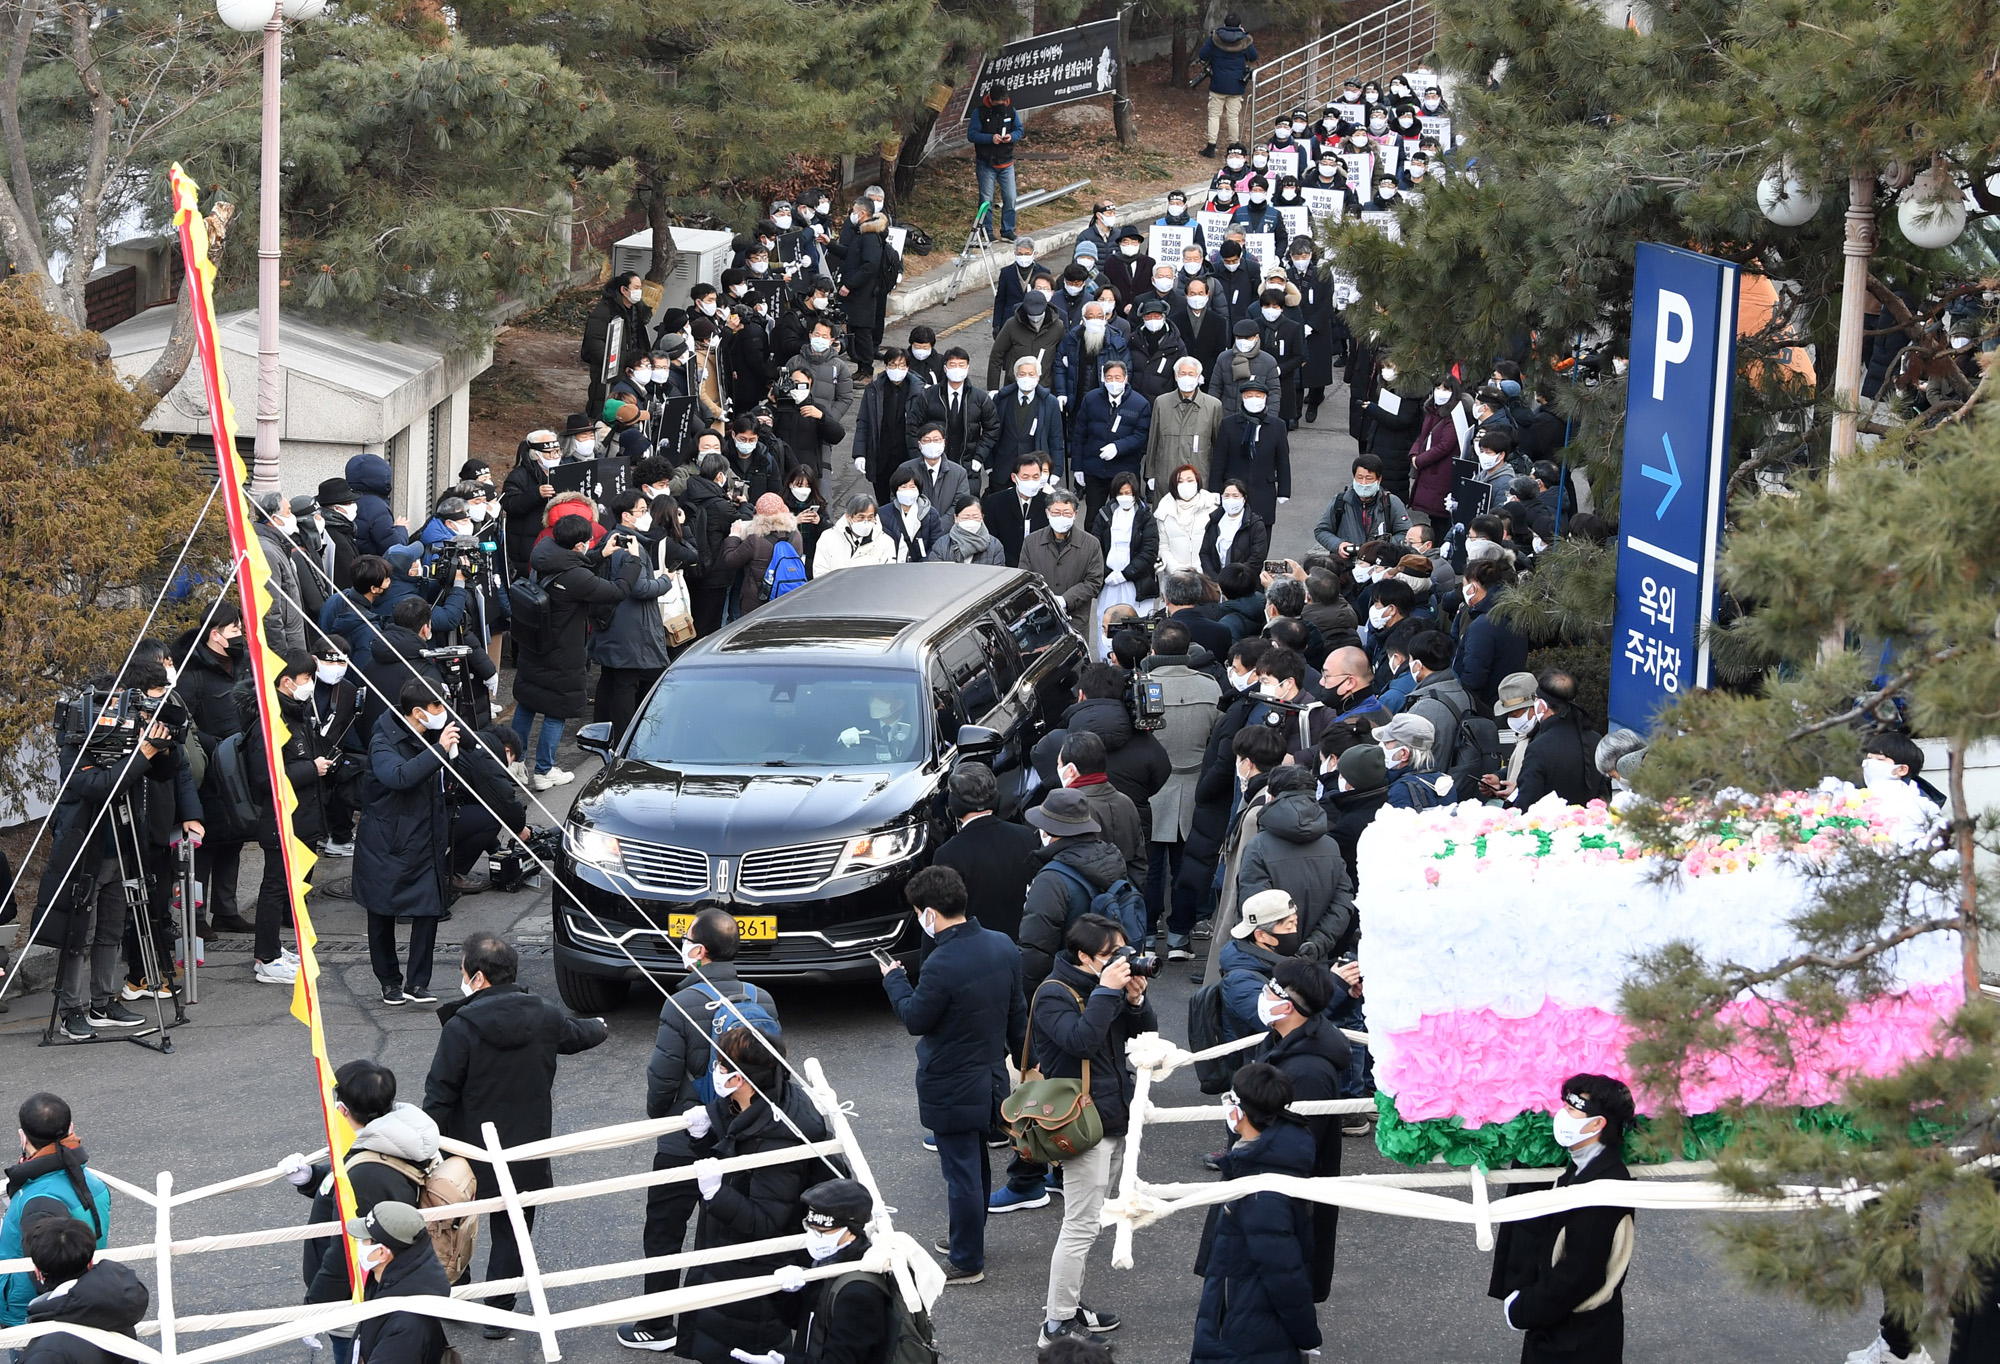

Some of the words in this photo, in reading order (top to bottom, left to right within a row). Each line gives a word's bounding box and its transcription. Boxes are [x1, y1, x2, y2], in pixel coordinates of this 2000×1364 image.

[995, 54, 1014, 72] 백기완
[1014, 50, 1032, 69] 선생님
[1032, 49, 1039, 65] 뜻
[1040, 43, 1063, 63] 이어받아
[1006, 73, 1025, 91] 단결로
[1026, 67, 1051, 86] 노동존중
[1051, 64, 1064, 82] 세상
[1064, 57, 1093, 79] 열겠습니다
[1652, 288, 1693, 400] P
[1639, 576, 1676, 633] 옥외
[1625, 629, 1681, 693] 주차장
